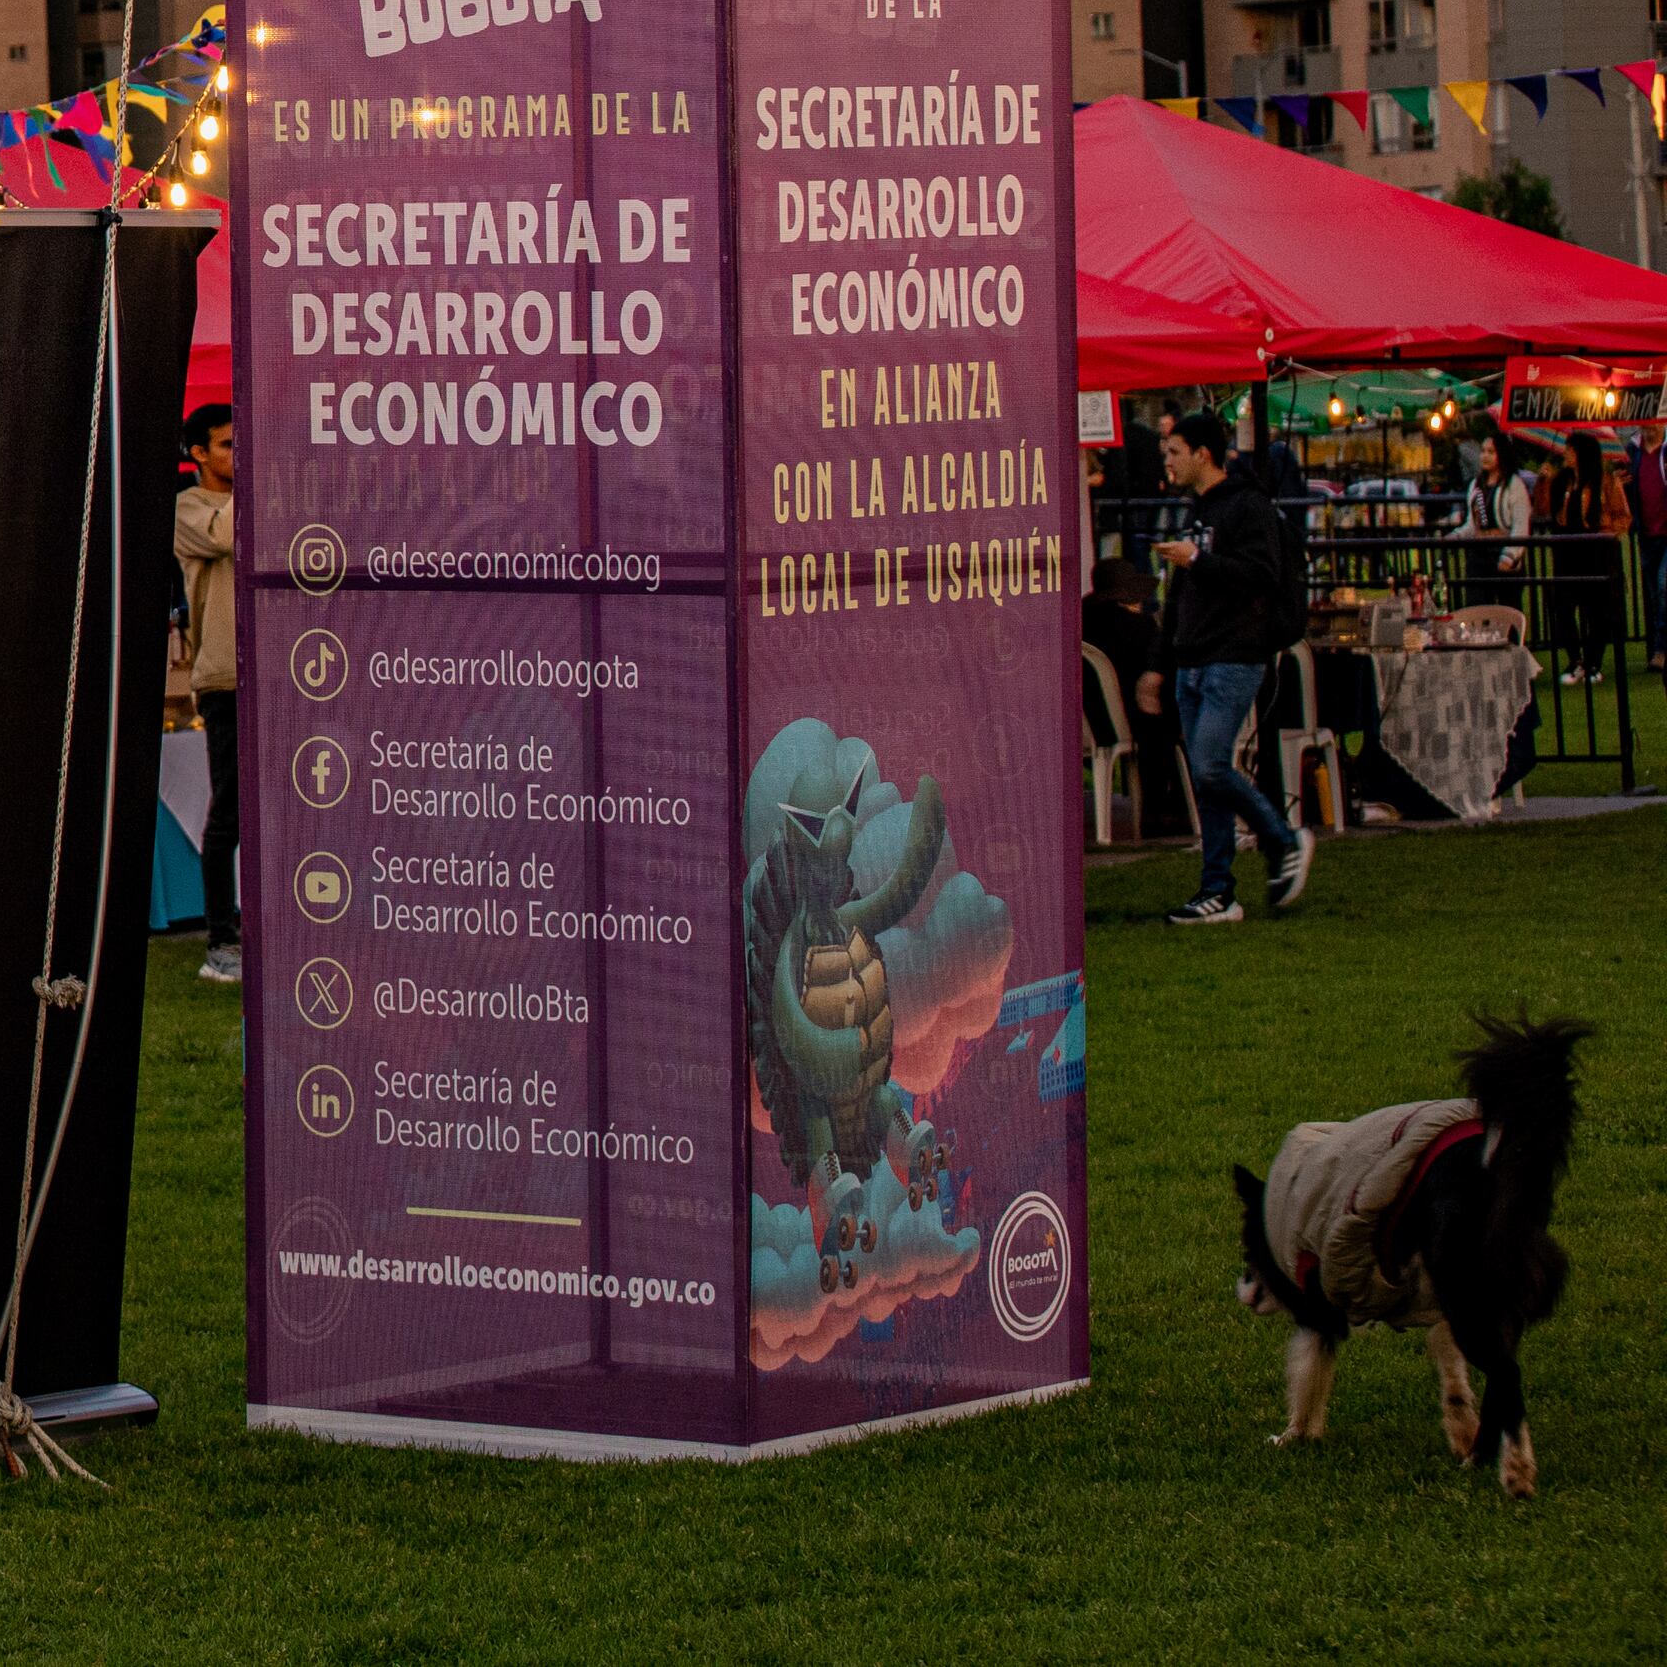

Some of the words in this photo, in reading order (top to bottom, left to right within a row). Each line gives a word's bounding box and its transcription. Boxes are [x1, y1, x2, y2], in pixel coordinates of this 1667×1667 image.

[274, 99, 310, 142] ES
[330, 98, 368, 141] UN
[390, 94, 571, 140] PROGRAMA
[592, 92, 630, 135] DE
[651, 90, 690, 134] LA
[756, 69, 985, 150] SECRETARÍA
[995, 84, 1041, 145] DE
[262, 183, 602, 268] SECRETARÍA
[618, 198, 691, 263] DE
[778, 174, 1024, 243] DESARROLLO
[292, 289, 663, 356] DESARROLLO
[792, 253, 1024, 336] ECONÓMICO
[310, 365, 663, 447] ECONÓMICO
[821, 368, 856, 429] EN
[874, 360, 1002, 426] ALIANZA
[773, 461, 832, 524] CON
[850, 457, 886, 518] LA
[901, 438, 1048, 514] ALCALDÍA
[368, 542, 660, 592] @deseconomicobog
[761, 550, 859, 617] LOCAL
[875, 546, 910, 607] DE
[926, 527, 1061, 607] USAQUÉN
[369, 647, 639, 697] @desarrollobogota
[370, 730, 508, 771] Secretaría
[518, 735, 553, 772] de
[371, 778, 516, 820] Desarrollo
[527, 783, 691, 825] Económico
[372, 846, 511, 887] Secretaría
[520, 852, 555, 889] de
[373, 894, 518, 936] Desarrollo
[528, 900, 692, 944] Económico
[373, 978, 589, 1023] @DesarrolloBta
[374, 1060, 513, 1104] Secretaría
[522, 1070, 557, 1108] de
[375, 1108, 520, 1153] Desarrollo
[531, 1118, 695, 1164] Económico
[279, 1249, 716, 1308] www.desarrolloeconomico.gov.co
